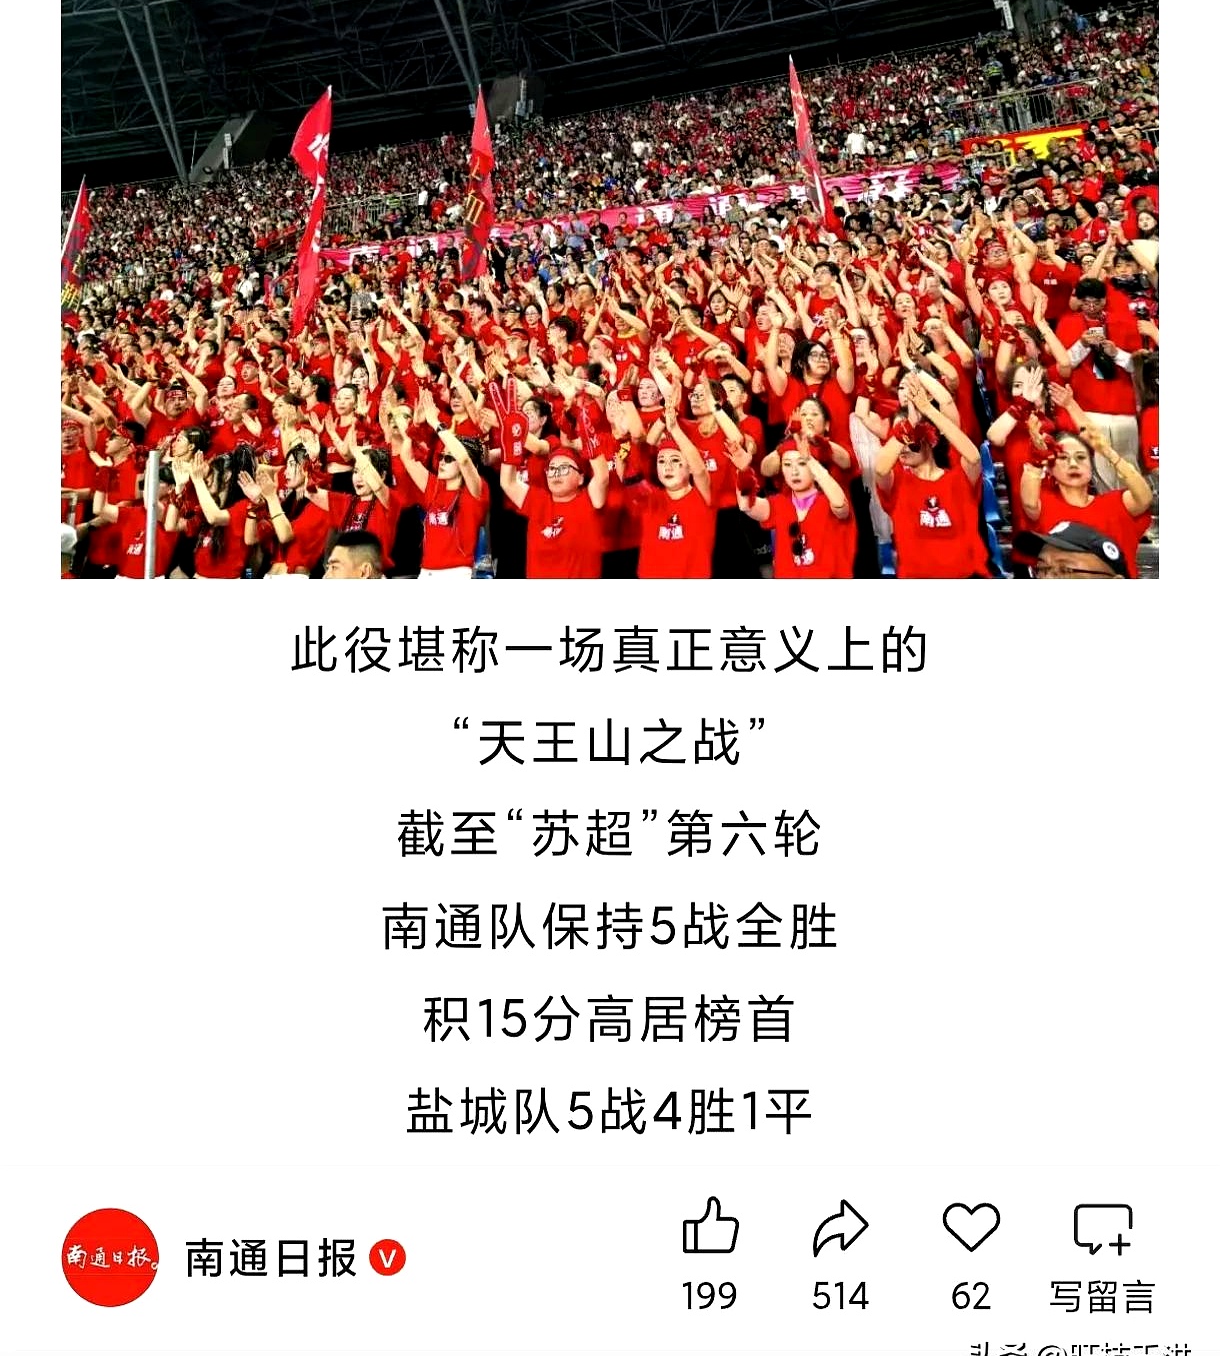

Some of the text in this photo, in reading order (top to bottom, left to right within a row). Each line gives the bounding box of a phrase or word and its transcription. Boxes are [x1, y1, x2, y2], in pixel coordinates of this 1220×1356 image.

[291, 625, 926, 673] 此役堪称一场真正意义上的
[453, 716, 765, 766] “天王山之战”
[397, 808, 821, 858] 截至“苏超”第六轮
[382, 901, 837, 950] 南通队保持5战全胜
[423, 994, 795, 1043] 积15分高居榜首
[406, 1087, 812, 1135] 盐城队5战4胜1平
[185, 1237, 357, 1278] 南通日报
[682, 1281, 737, 1310] 199
[812, 1281, 870, 1310] 514
[951, 1281, 991, 1310] 62
[1049, 1279, 1156, 1314] 写留言
